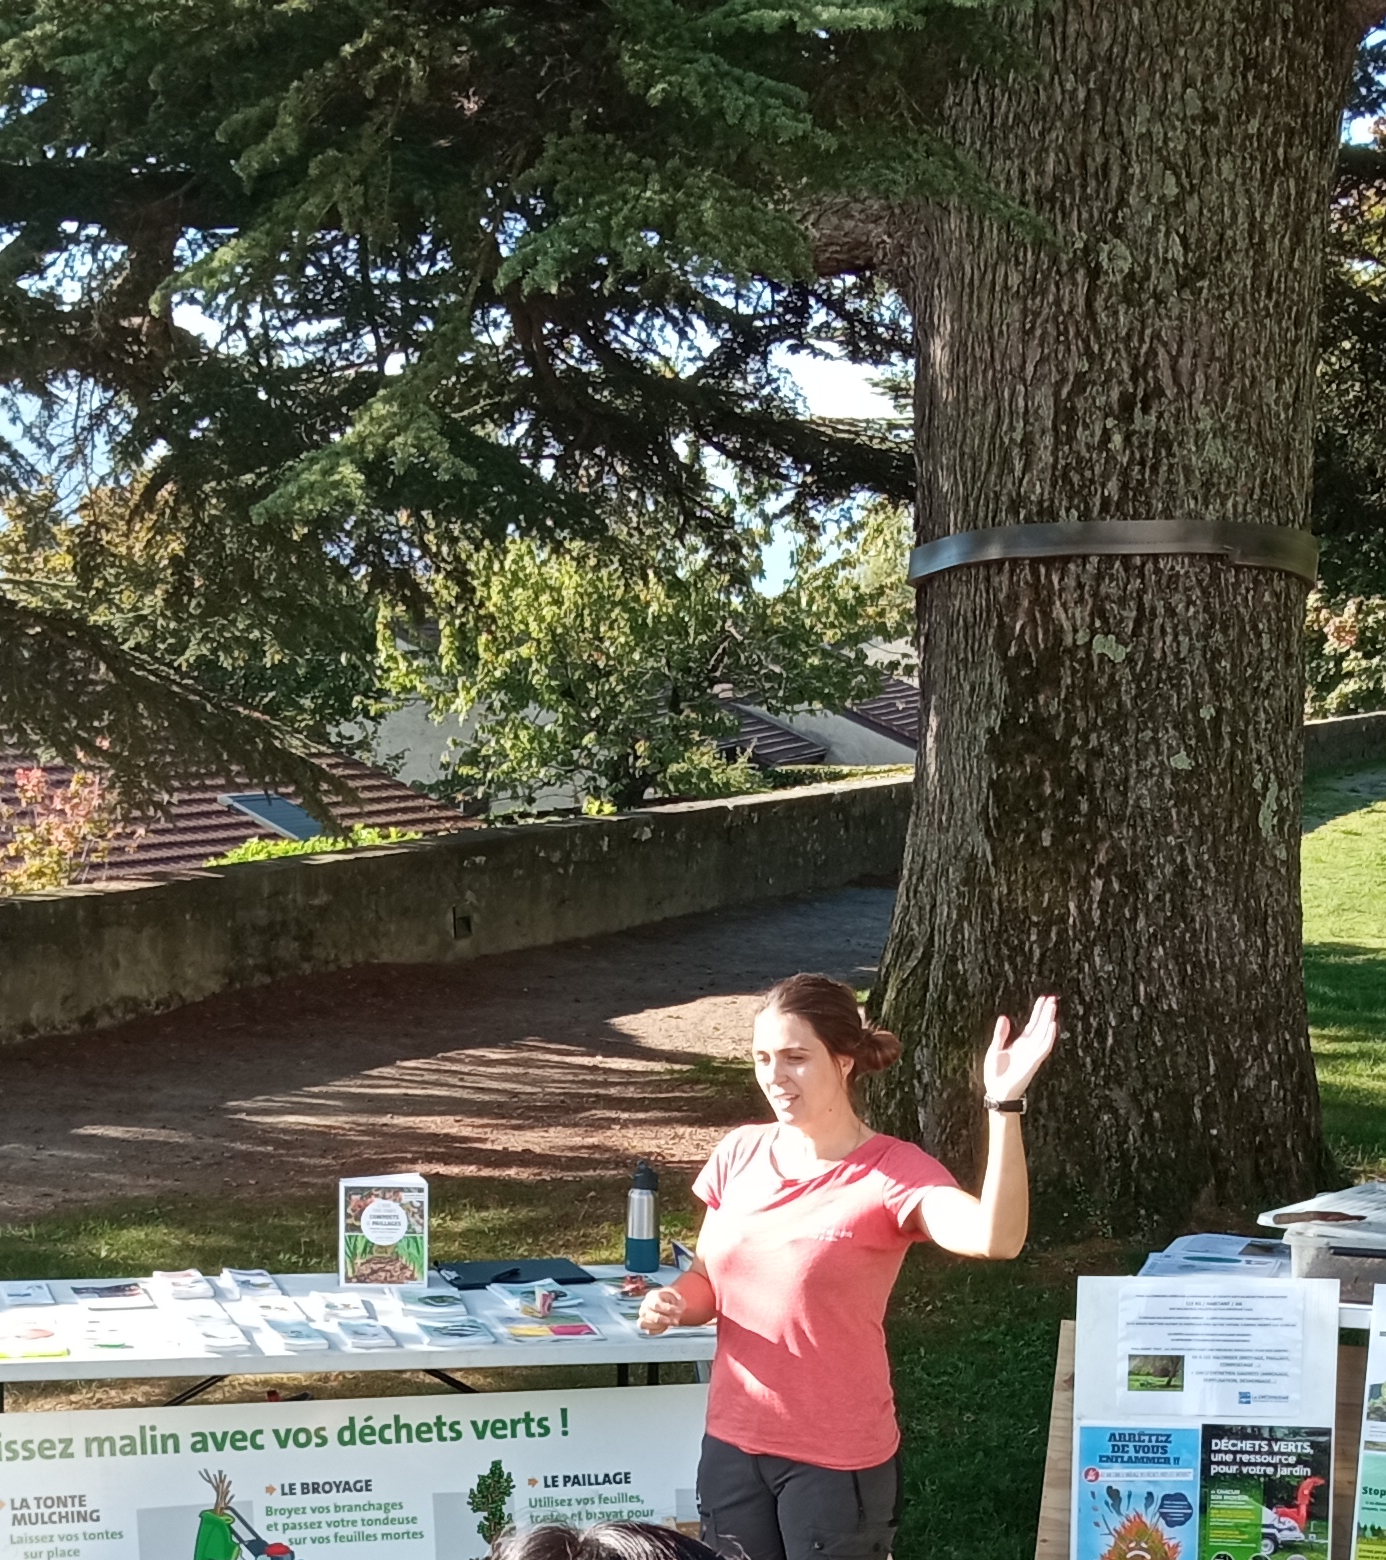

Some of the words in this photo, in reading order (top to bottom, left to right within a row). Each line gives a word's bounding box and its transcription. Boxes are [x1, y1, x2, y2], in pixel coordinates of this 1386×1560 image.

[84, 1425, 181, 1458] malin
[190, 1427, 264, 1454] avec
[272, 1423, 329, 1450] vos
[336, 1413, 463, 1448] déchets
[470, 1409, 551, 1441] verts
[1107, 1431, 1173, 1444] ARRÊTEZ
[1111, 1444, 1130, 1454] DE
[1132, 1445, 1169, 1455] VOUS
[1211, 1438, 1269, 1452] DÉCHETS
[1271, 1440, 1314, 1454] VERTS,
[1098, 1455, 1172, 1466] ENFLAMMER
[1210, 1453, 1233, 1462] une
[1236, 1453, 1297, 1464] ressource
[1210, 1465, 1239, 1476] pour
[1241, 1466, 1275, 1475] votre
[1276, 1465, 1312, 1477] jardin
[280, 1483, 297, 1497] LE
[300, 1478, 373, 1496] BROYAGE
[543, 1475, 559, 1489] LE
[562, 1471, 632, 1488] PAILLAGE
[528, 1496, 573, 1509] Utilisez
[575, 1497, 595, 1506] vos
[598, 1492, 645, 1505] feuilles,
[1361, 1486, 1386, 1498] Stop
[10, 1497, 30, 1511] LA
[34, 1494, 87, 1511] TONTE
[265, 1505, 307, 1519] Broyez
[310, 1504, 331, 1515] vos
[334, 1500, 404, 1514] branchages
[11, 1508, 101, 1527] MULCHING
[627, 1508, 655, 1521] pour
[266, 1522, 279, 1532] et
[282, 1520, 323, 1534] passez
[325, 1518, 358, 1529] votre
[361, 1514, 418, 1528] tondeuse
[10, 1532, 55, 1546] Laissez
[58, 1533, 80, 1543] vos
[83, 1527, 125, 1541] tontes
[288, 1536, 307, 1546] sur
[310, 1534, 331, 1545] vos
[334, 1531, 378, 1544] feuilles
[381, 1529, 424, 1542] mortes
[23, 1549, 43, 1560] sur
